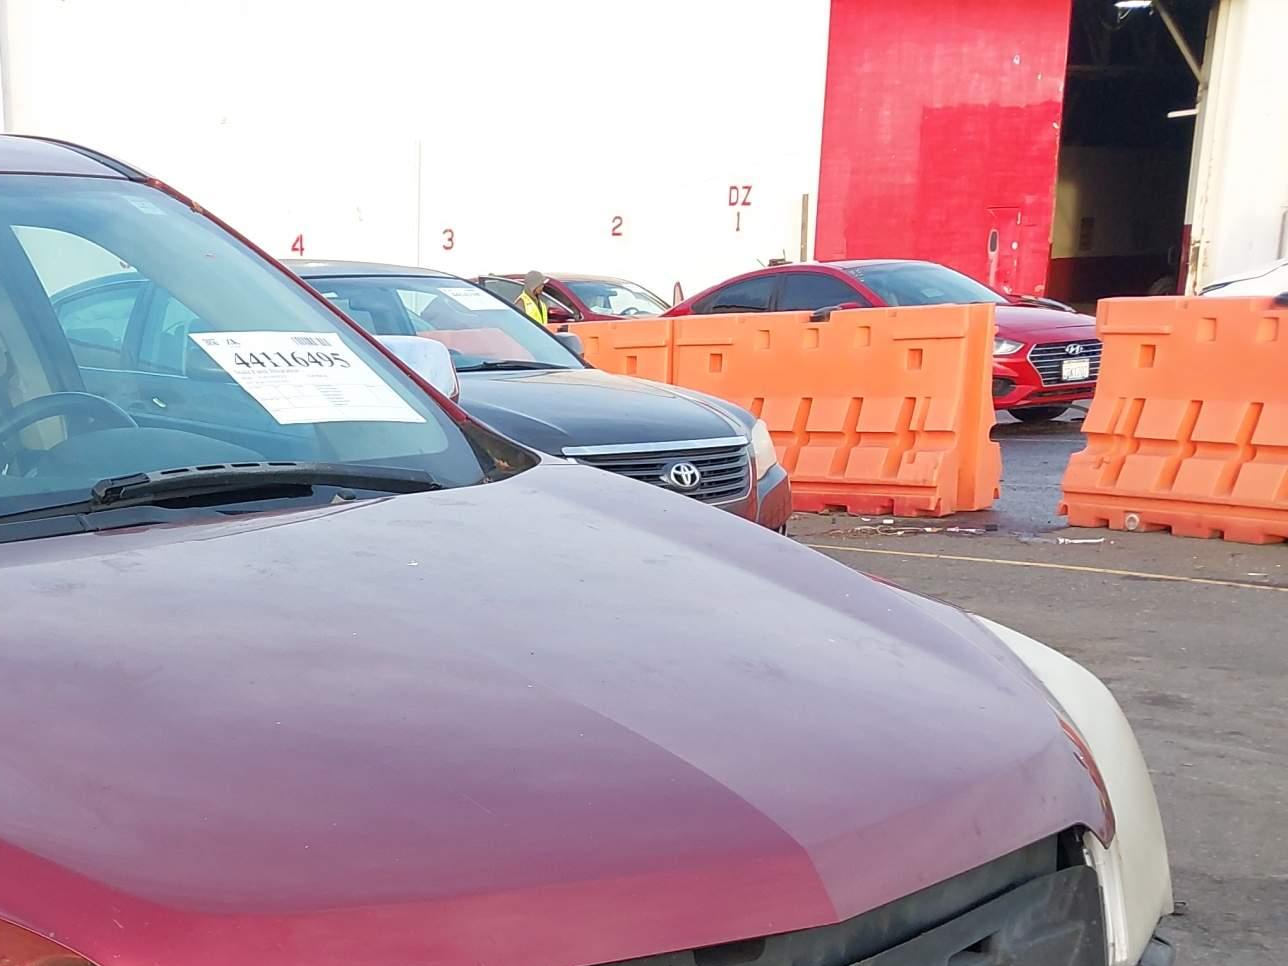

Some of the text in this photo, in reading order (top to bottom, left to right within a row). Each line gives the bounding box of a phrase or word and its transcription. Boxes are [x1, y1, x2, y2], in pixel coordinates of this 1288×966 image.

[728, 184, 753, 206] DZ
[611, 215, 624, 236] 2
[735, 211, 741, 232] 1
[290, 233, 305, 257] 4
[442, 228, 455, 250] 3
[233, 350, 352, 370] 44116495
